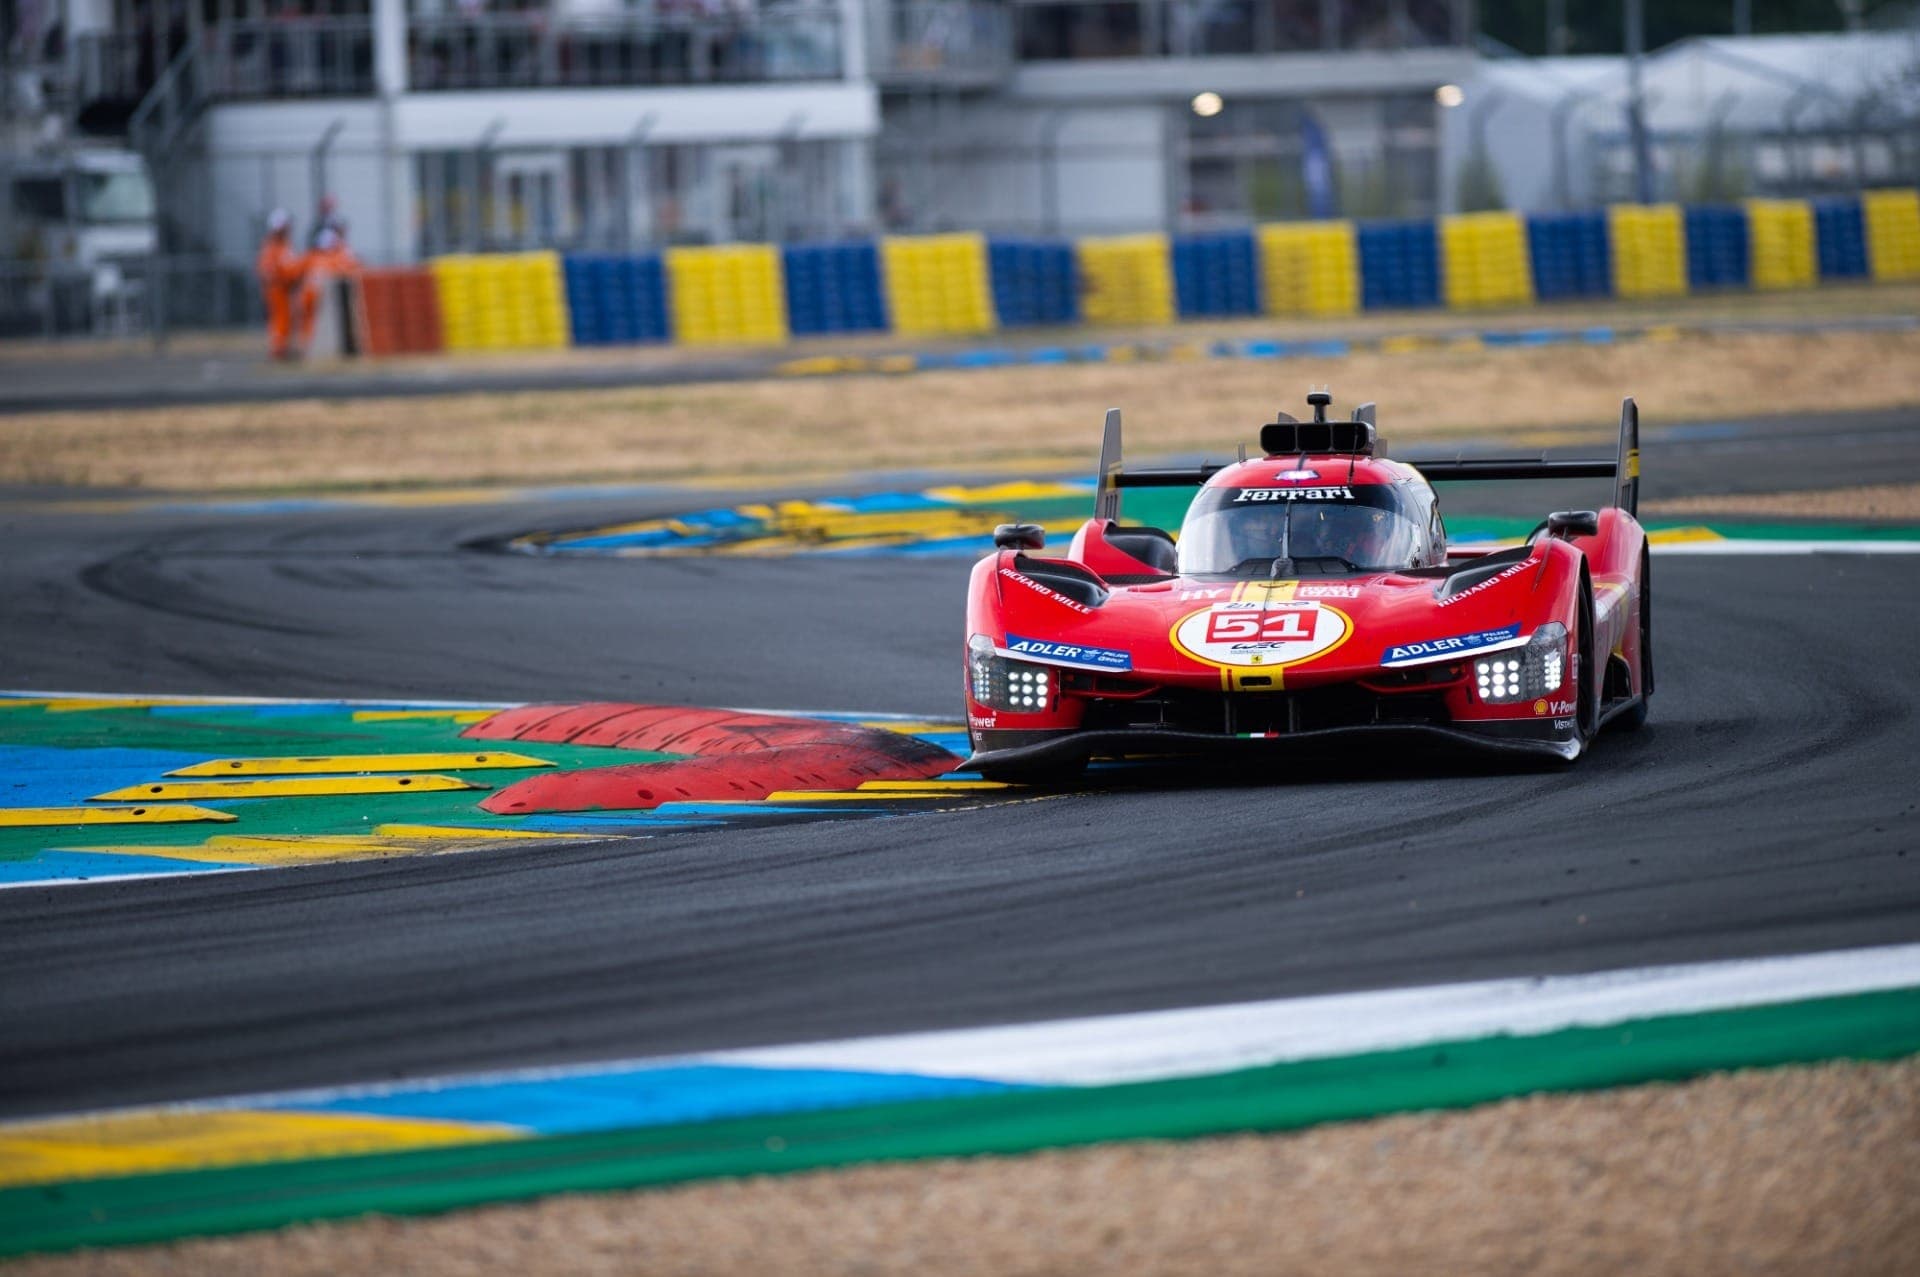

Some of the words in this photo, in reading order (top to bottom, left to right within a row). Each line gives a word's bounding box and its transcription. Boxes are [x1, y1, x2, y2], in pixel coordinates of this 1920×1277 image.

[1233, 486, 1355, 502] Ferrari
[999, 568, 1052, 595] RICHARD
[1051, 593, 1092, 614] MILLE
[1438, 577, 1500, 607] RICHARD
[1500, 557, 1540, 578] MILLE
[1181, 588, 1224, 600] HY
[1213, 613, 1309, 638] 51
[1009, 641, 1081, 659] ADLER
[1391, 638, 1464, 658] ADLER
